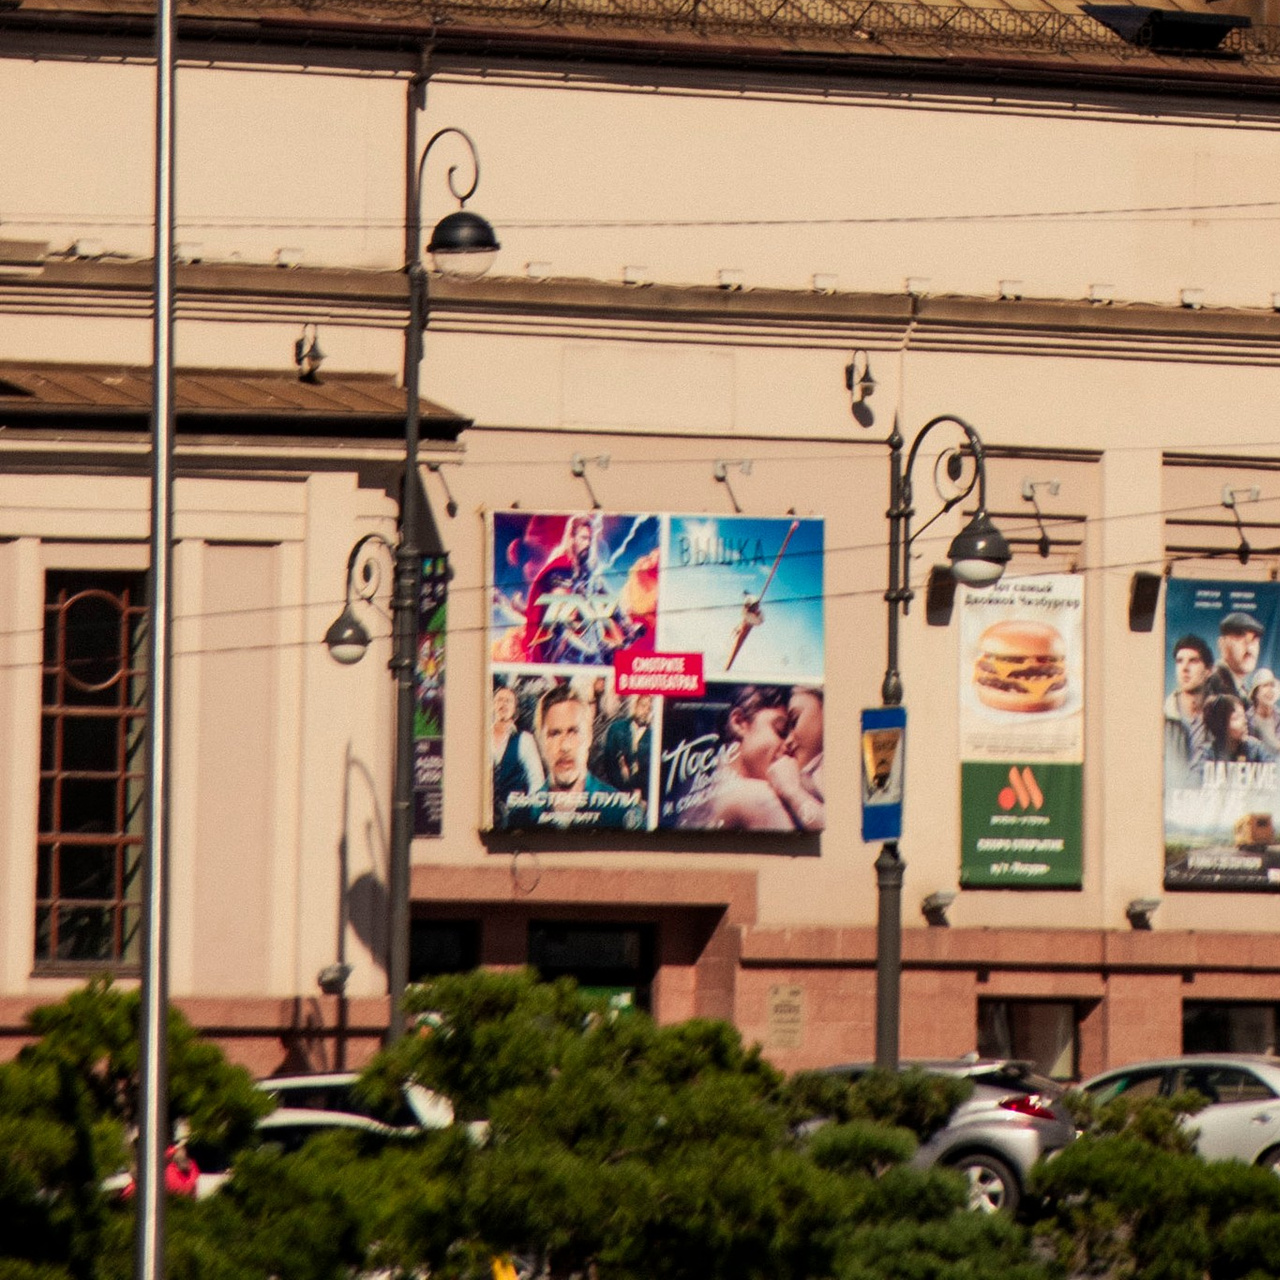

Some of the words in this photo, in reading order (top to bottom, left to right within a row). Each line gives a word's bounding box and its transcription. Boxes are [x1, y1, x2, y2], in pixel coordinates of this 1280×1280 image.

[678, 537, 767, 566] ВЫШКА
[661, 733, 741, 795] После
[506, 790, 588, 808] БЫСТРЕЕ
[589, 789, 642, 808] ПУЛИ
